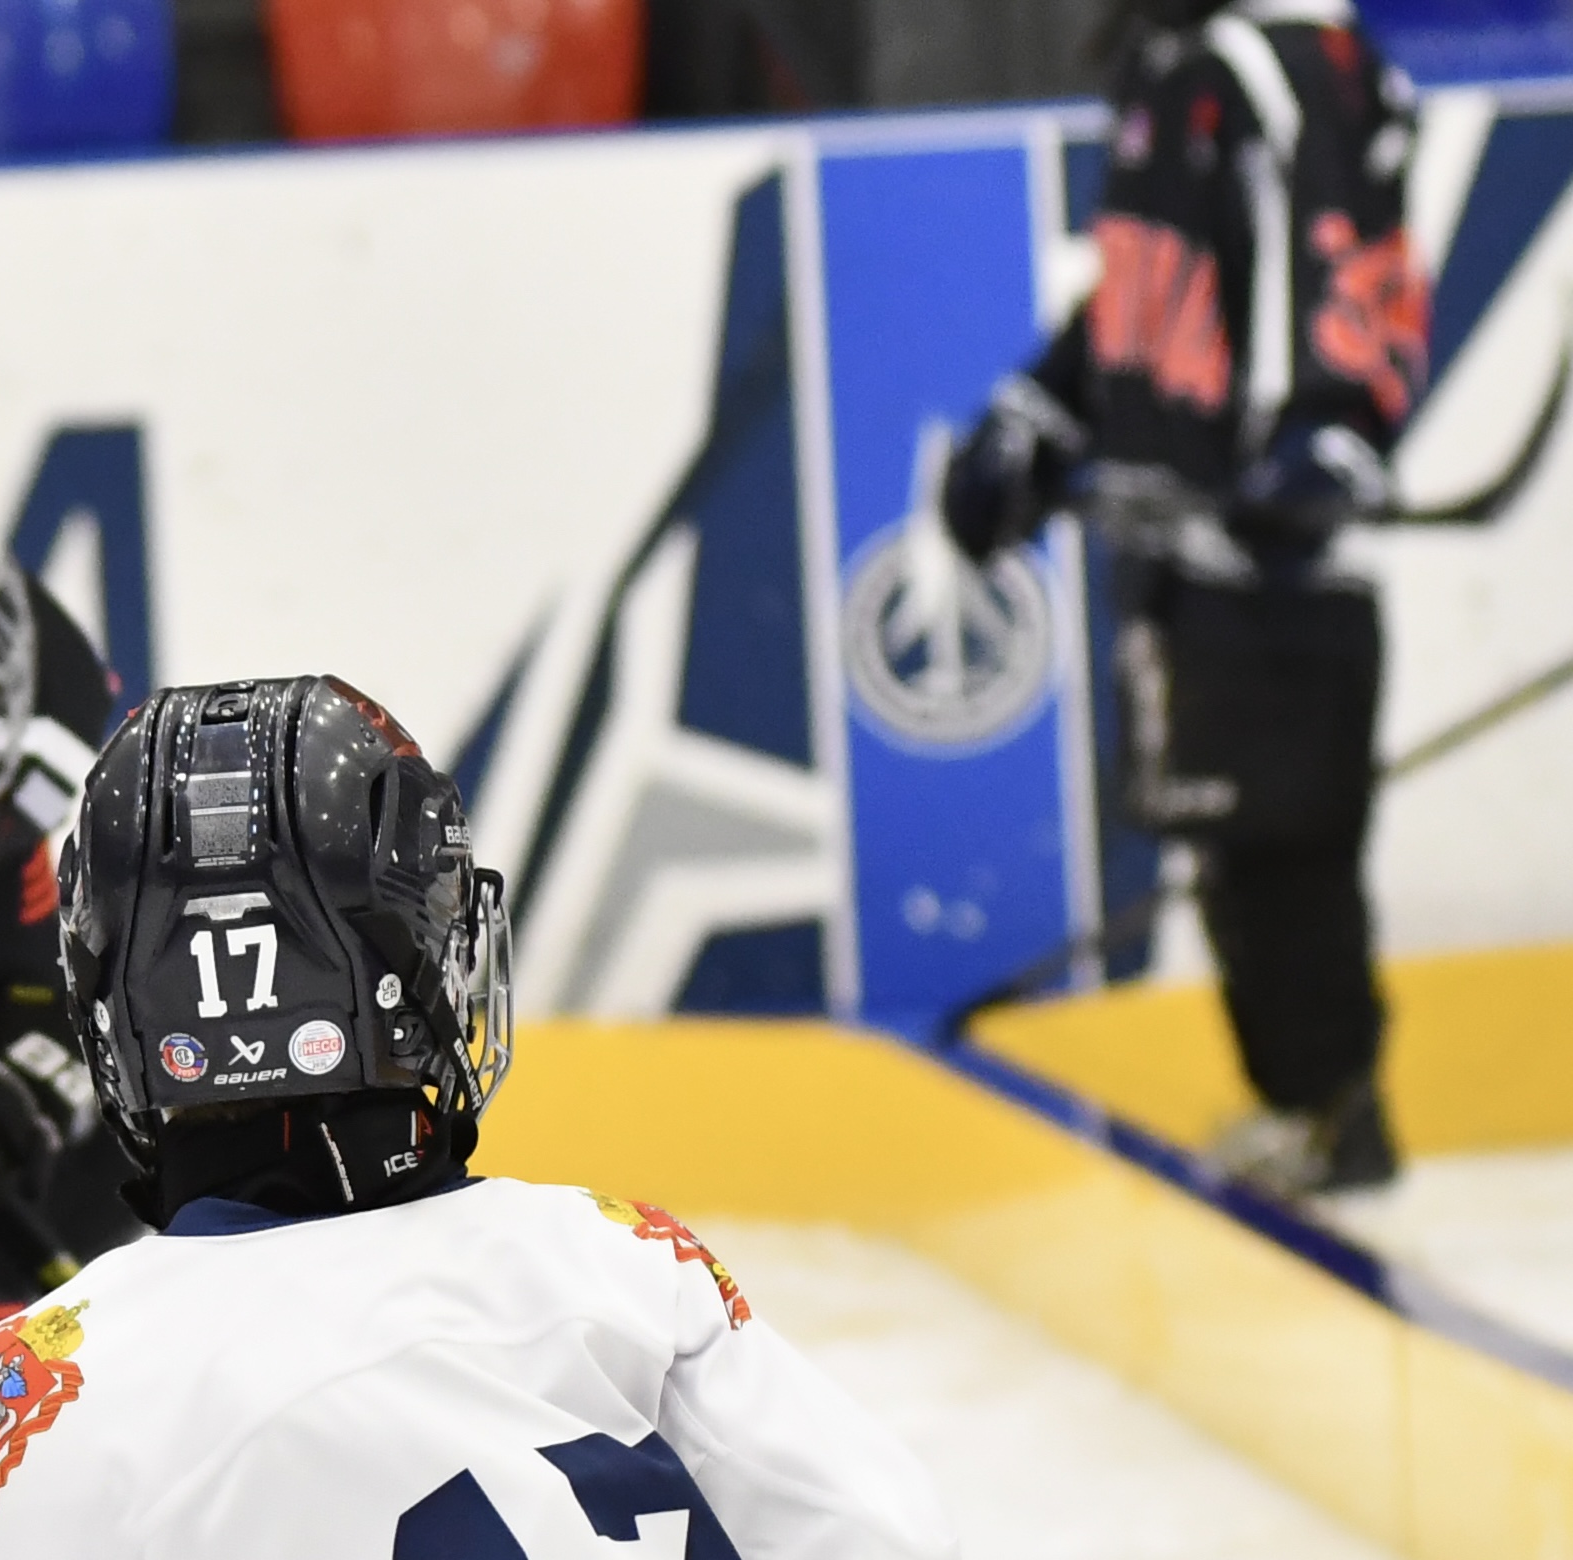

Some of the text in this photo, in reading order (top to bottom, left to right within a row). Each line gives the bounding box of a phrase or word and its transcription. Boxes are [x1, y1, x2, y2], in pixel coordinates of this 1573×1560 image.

[190, 923, 278, 1018] 17
[213, 1067, 287, 1085] BAUER
[453, 1037, 483, 1110] BAUER
